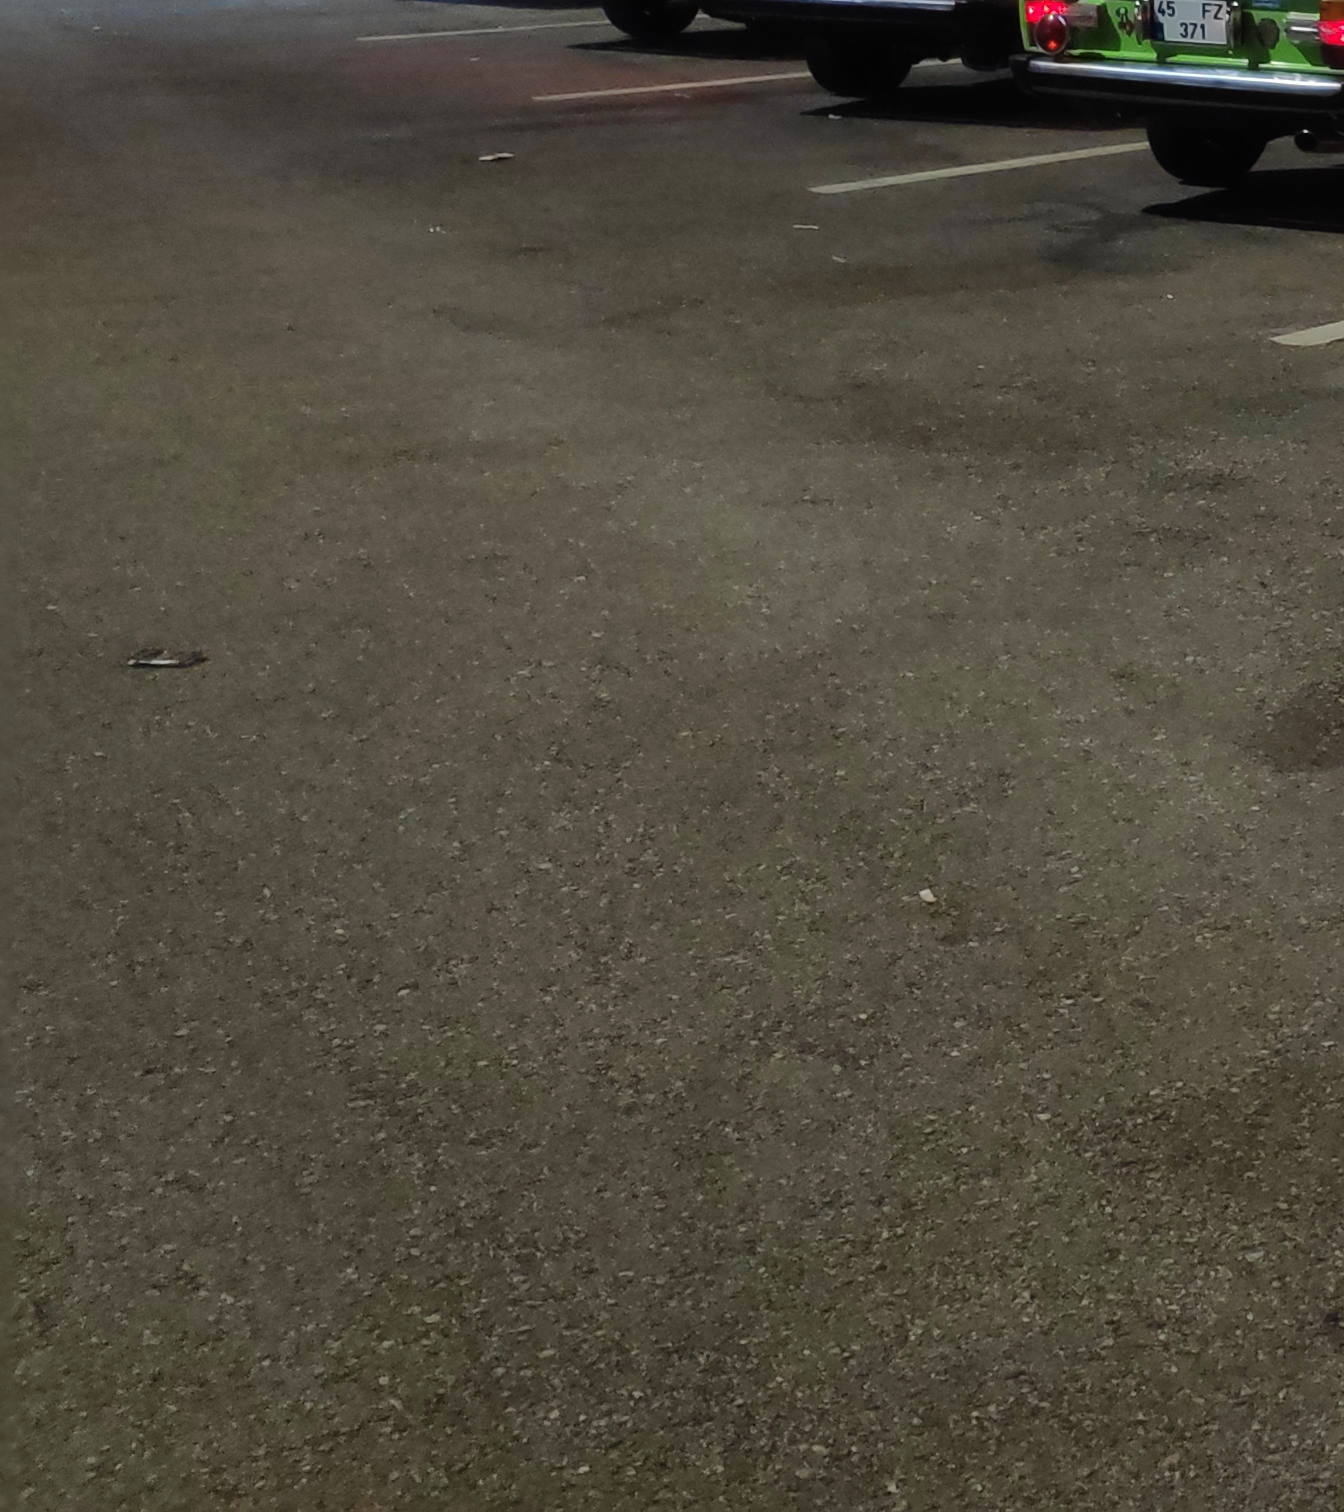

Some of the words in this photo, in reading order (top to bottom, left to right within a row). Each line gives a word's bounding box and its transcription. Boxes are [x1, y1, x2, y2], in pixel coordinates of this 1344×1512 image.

[1157, 0, 1176, 18] 45
[1201, 2, 1224, 21] FZ
[1179, 22, 1206, 39] 371
